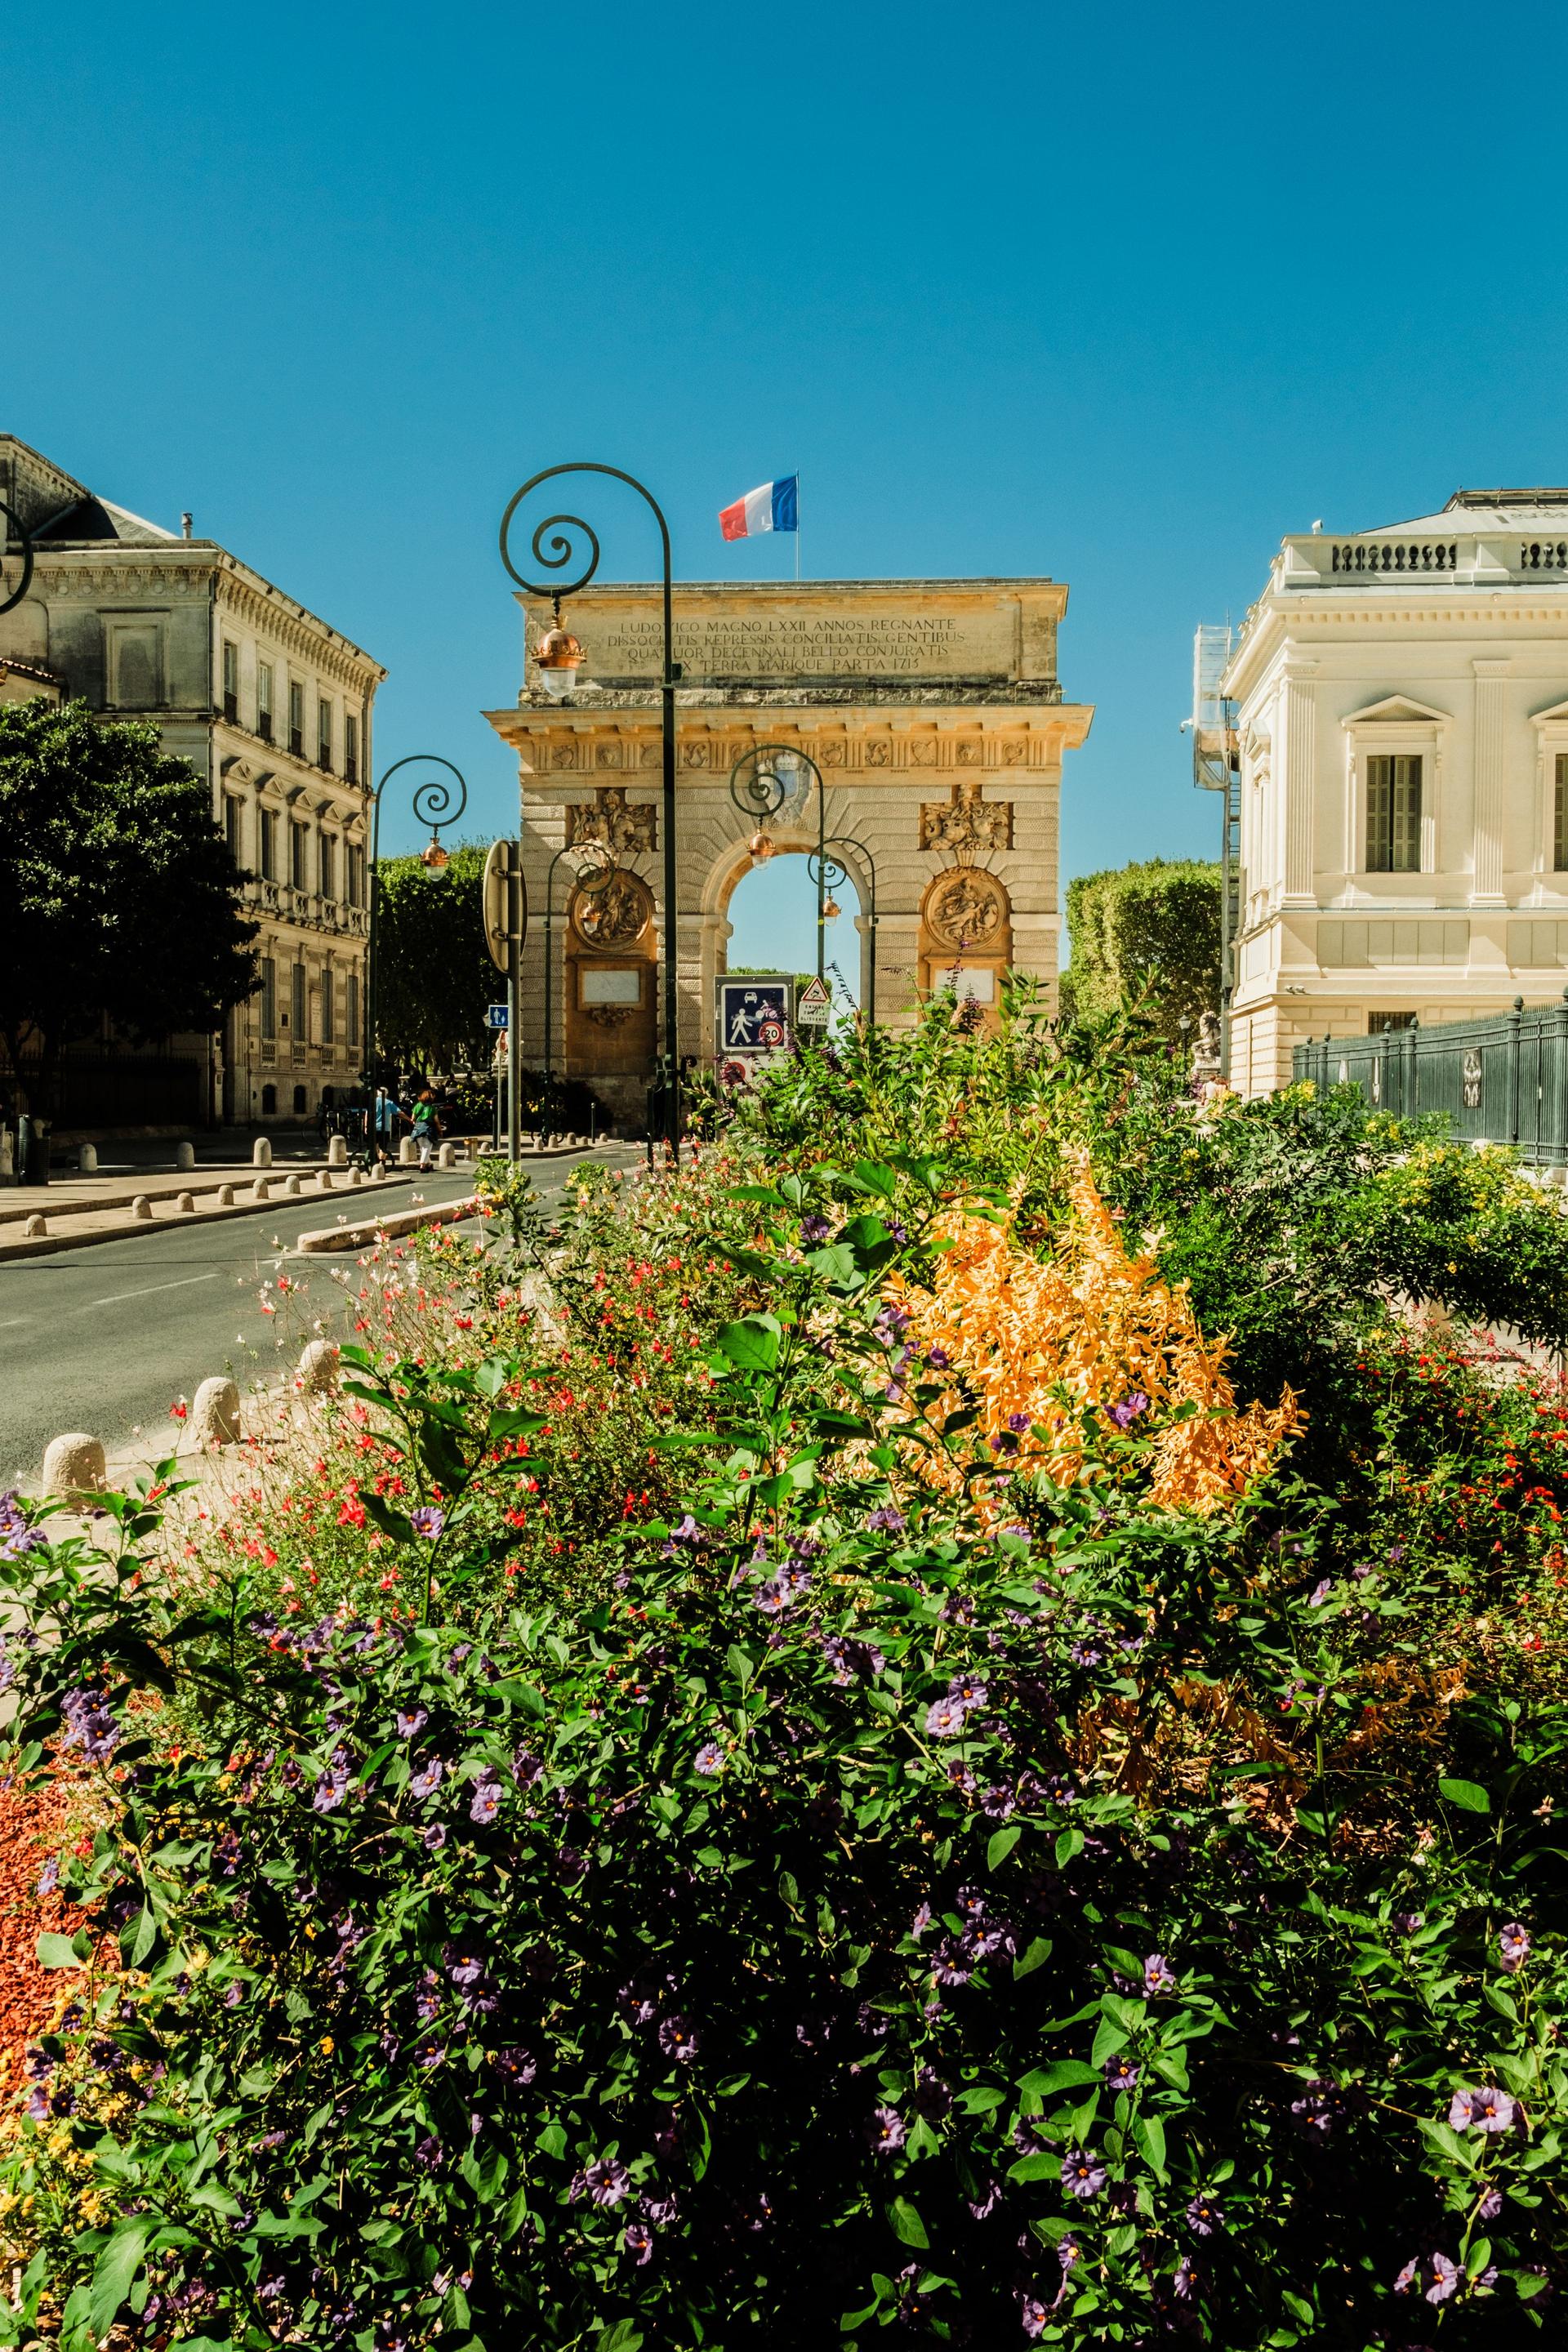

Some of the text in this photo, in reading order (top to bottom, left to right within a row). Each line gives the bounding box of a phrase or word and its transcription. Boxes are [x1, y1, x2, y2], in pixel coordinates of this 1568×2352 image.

[621, 618, 956, 634] LUDOICO MAGNO LXXII ANNOS REGNANTE
[608, 631, 964, 647] DISSOCITIS REPRESSIS CONCILIATIS GENTIBUS
[628, 644, 948, 662] QUAUOR DECENNALI BELLO CONJURATIS
[700, 659, 751, 672] TERRA
[758, 658, 825, 672] MARIQUE
[833, 658, 884, 670] PARTA
[893, 657, 919, 670] 1715
[765, 1029, 778, 1039] 20
